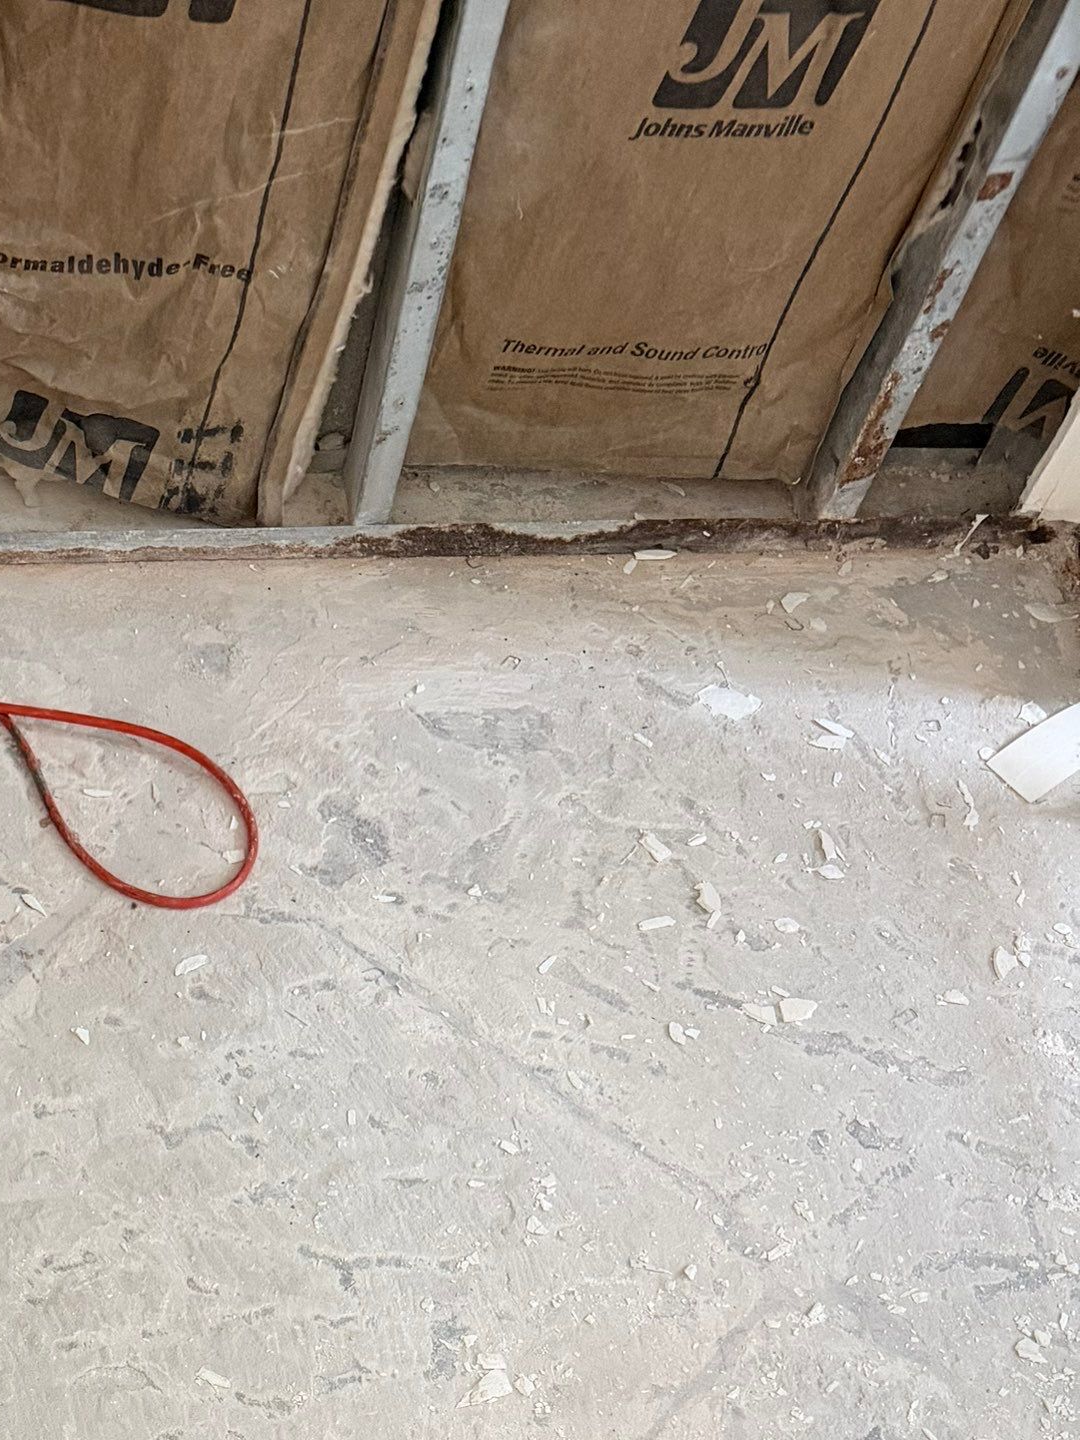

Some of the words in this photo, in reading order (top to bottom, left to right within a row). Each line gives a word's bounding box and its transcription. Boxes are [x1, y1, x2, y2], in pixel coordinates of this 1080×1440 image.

[628, 117, 708, 141] Johns
[708, 114, 815, 139] Manville
[502, 339, 586, 357] Thermal
[587, 342, 629, 356] and
[630, 341, 700, 361] Sound
[702, 342, 771, 360] Contro
